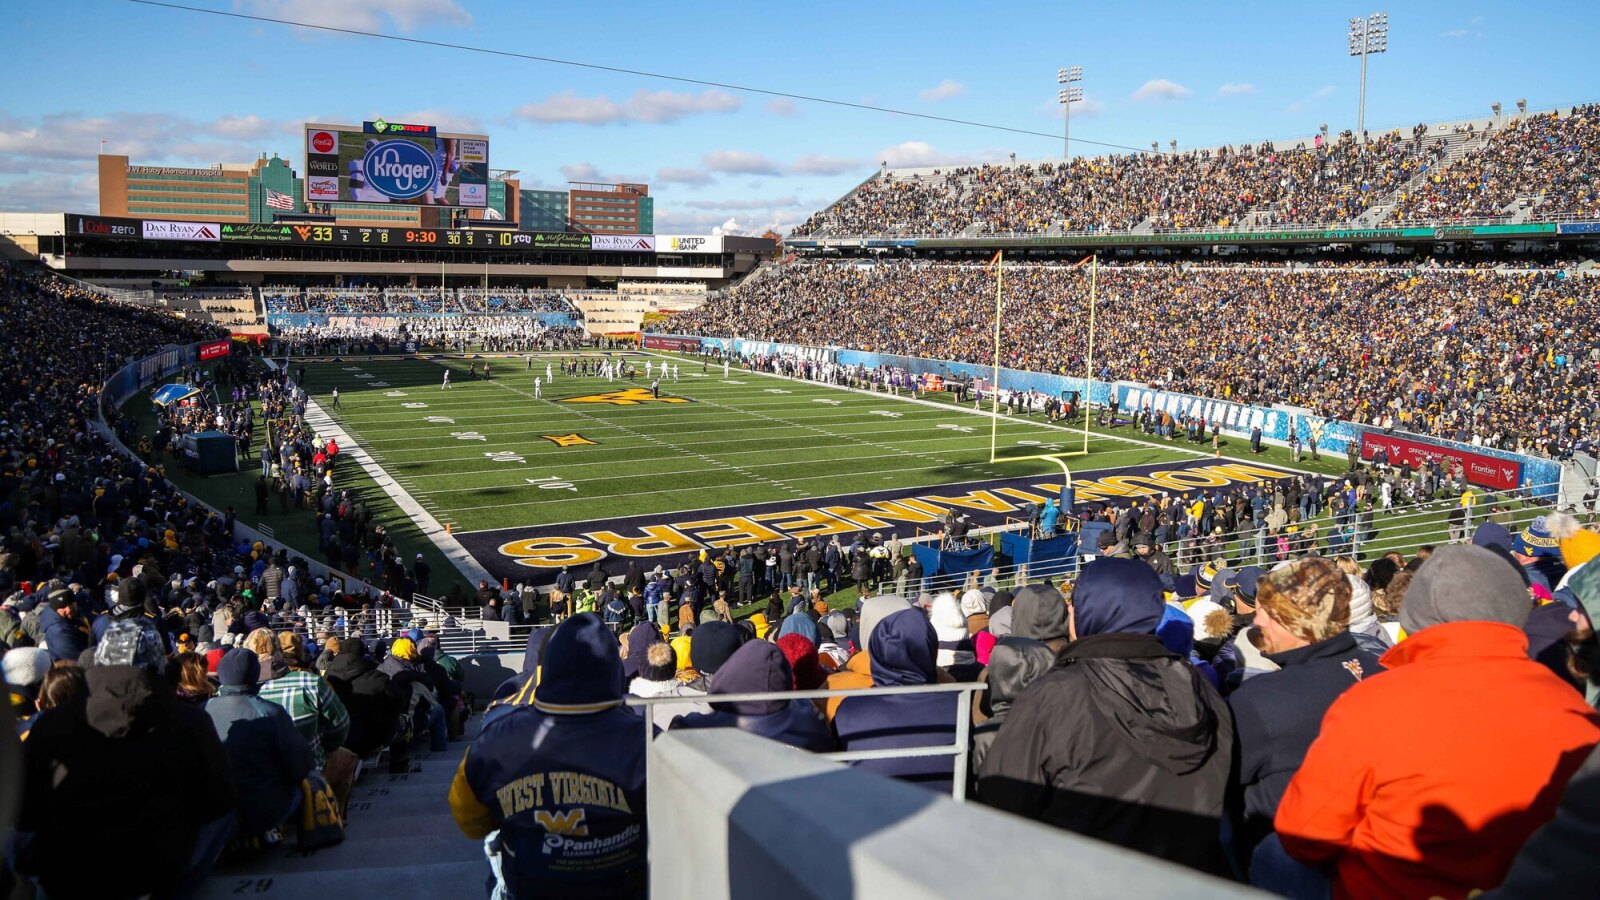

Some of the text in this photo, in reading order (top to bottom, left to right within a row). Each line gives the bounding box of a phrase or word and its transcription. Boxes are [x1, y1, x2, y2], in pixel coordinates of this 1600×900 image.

[390, 124, 430, 133] gomart
[309, 161, 338, 171] WORLD
[374, 148, 430, 191] Kroger
[143, 167, 162, 176] Ruby
[163, 167, 194, 176] Memorial
[195, 169, 223, 178] Hospital
[84, 220, 136, 235] Coke zero
[145, 222, 195, 234] DAN RYAN
[149, 231, 191, 239] BUILDERS
[313, 227, 333, 241] 33
[362, 232, 370, 243] 2
[381, 232, 389, 243] 8
[405, 230, 437, 243] 9:30
[499, 232, 512, 246] 10
[513, 234, 532, 244] TCU
[1286, 232, 1325, 240] TWITTER
[447, 235, 461, 245] 30
[466, 235, 474, 245] 3
[594, 236, 634, 245] DAN RYAN
[678, 237, 706, 245] UNITED
[1125, 388, 1281, 435] MOUNTAINEERS
[1365, 440, 1387, 451] Frontier
[1408, 447, 1430, 457] OFFICIAL
[1470, 462, 1496, 476] Frontier
[526, 476, 575, 490] 10
[497, 463, 1297, 568] MOUNTAINEERS
[496, 771, 632, 819] WEST VIRGINIA
[563, 824, 641, 851] Panhandle
[233, 878, 274, 894] 29
